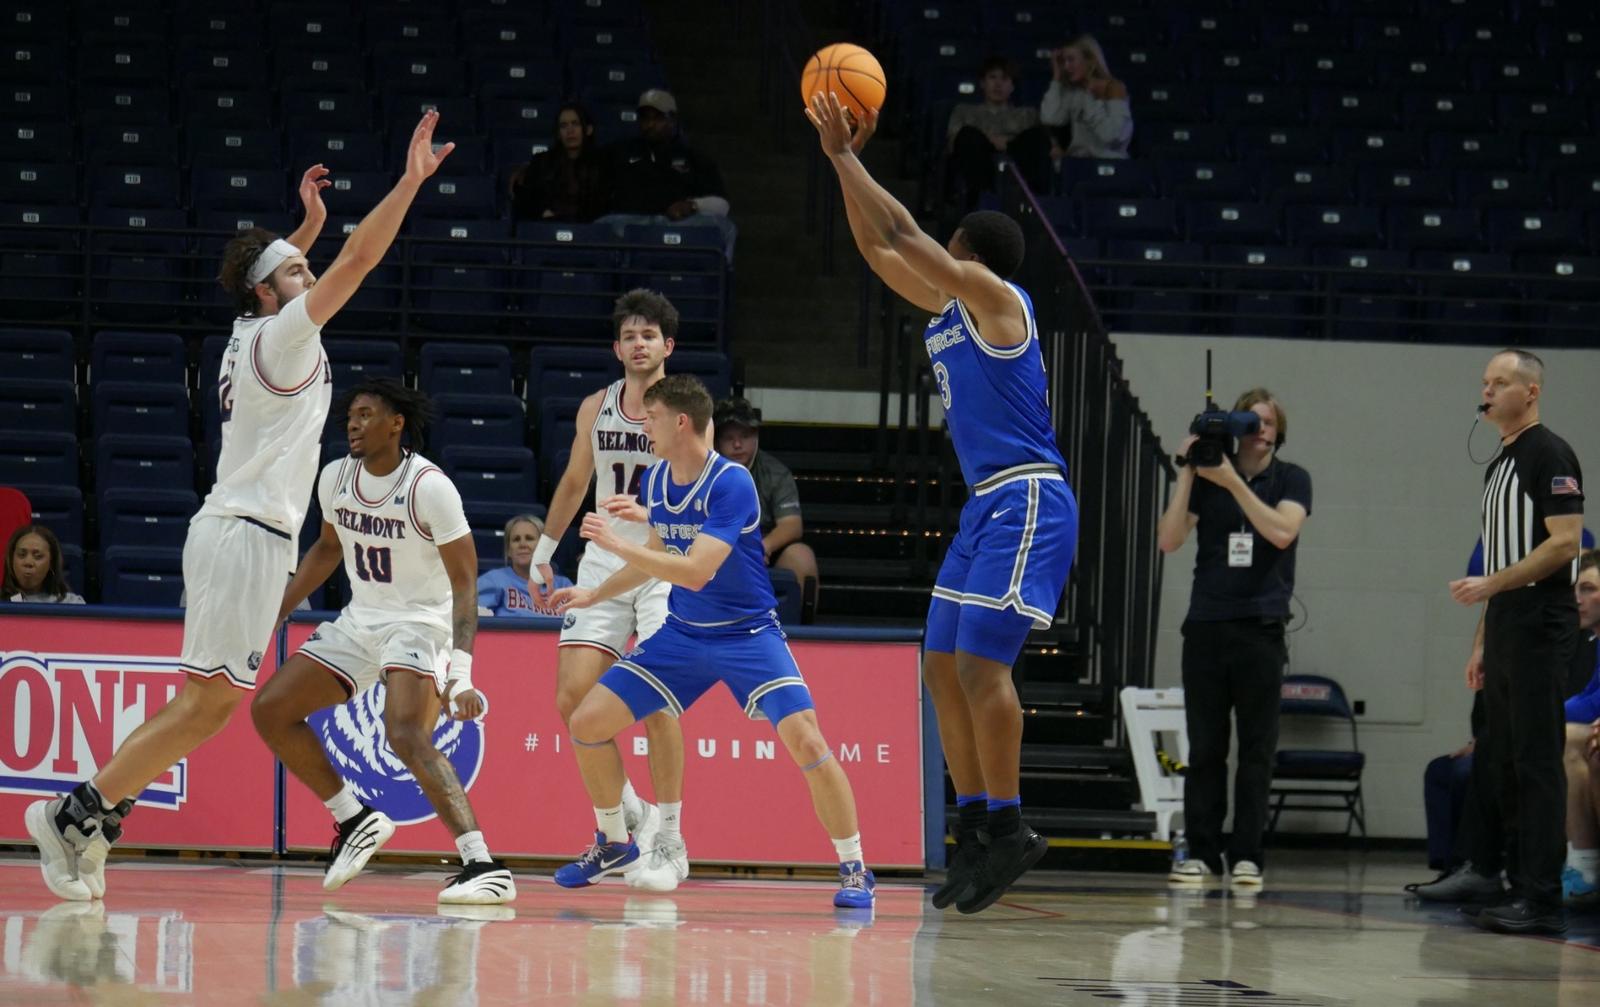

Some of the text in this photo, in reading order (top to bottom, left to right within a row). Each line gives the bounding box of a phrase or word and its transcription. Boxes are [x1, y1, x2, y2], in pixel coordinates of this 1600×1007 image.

[925, 324, 966, 357] FORCE
[933, 361, 951, 410] 3
[670, 523, 704, 540] FORC
[353, 541, 392, 583] 10
